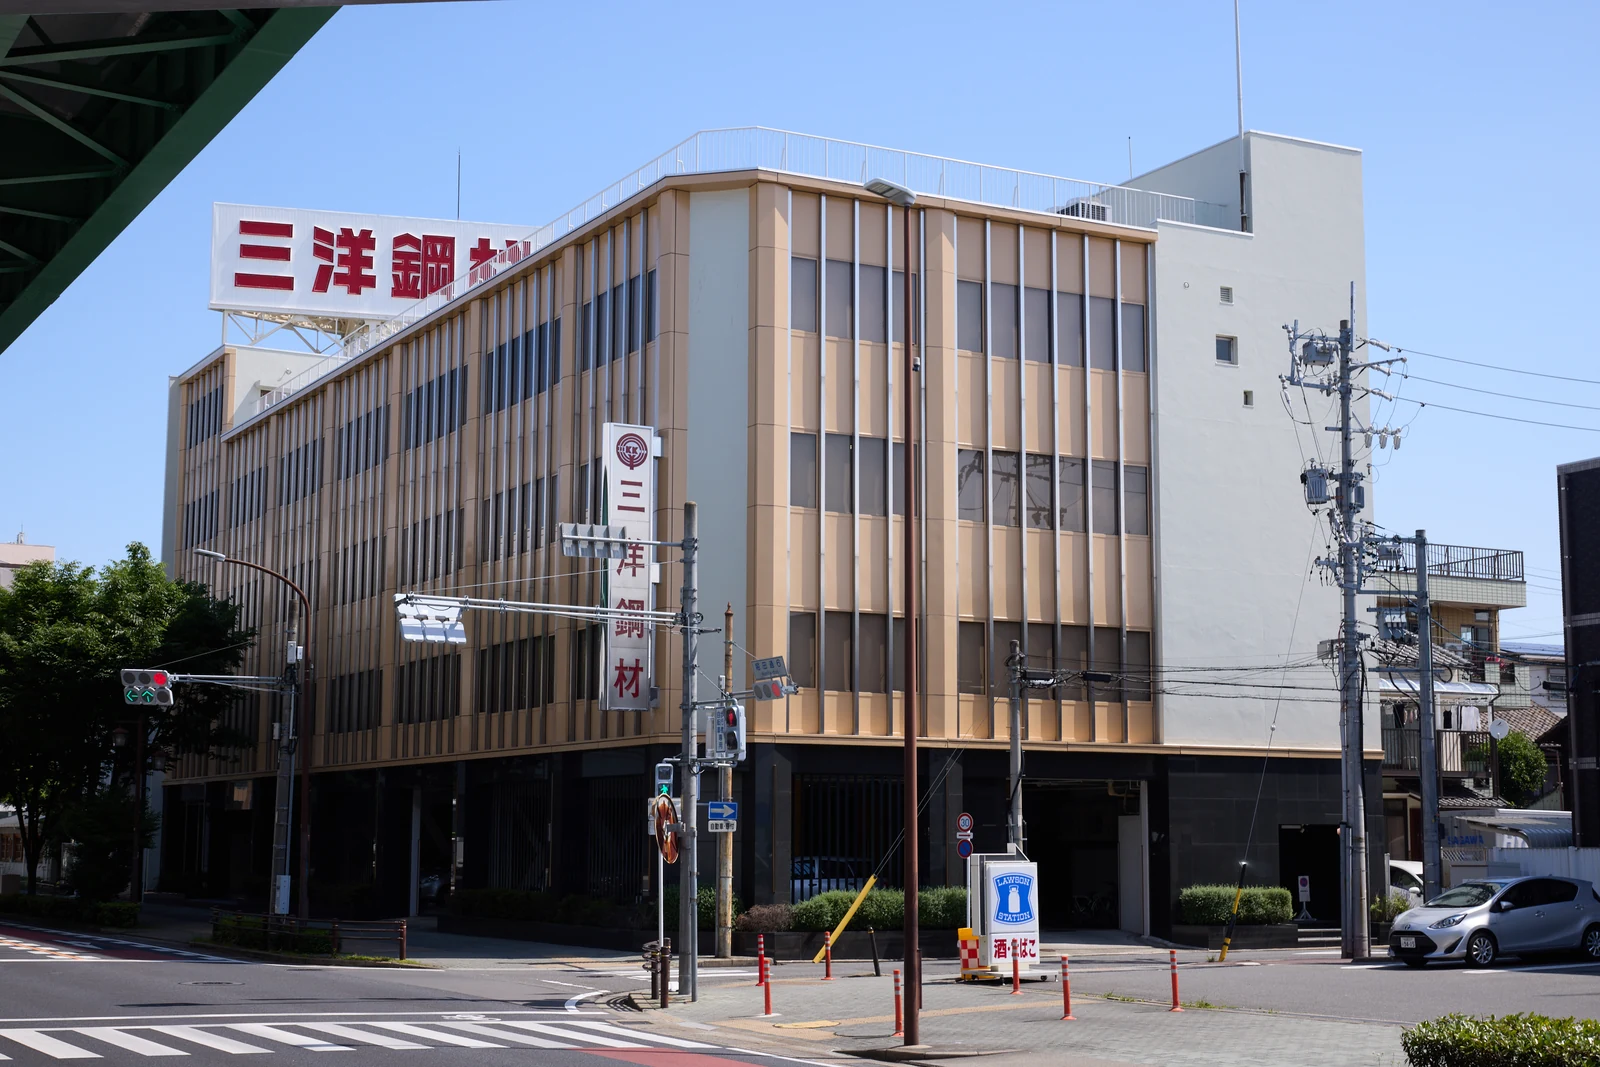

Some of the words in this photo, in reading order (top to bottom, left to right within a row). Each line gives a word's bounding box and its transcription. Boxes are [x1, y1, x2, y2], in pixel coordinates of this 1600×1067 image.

[960, 818, 970, 828] 30
[996, 876, 1030, 887] LAWSON
[997, 911, 1031, 922] STATION
[993, 938, 1036, 959] 酒・ばこ
